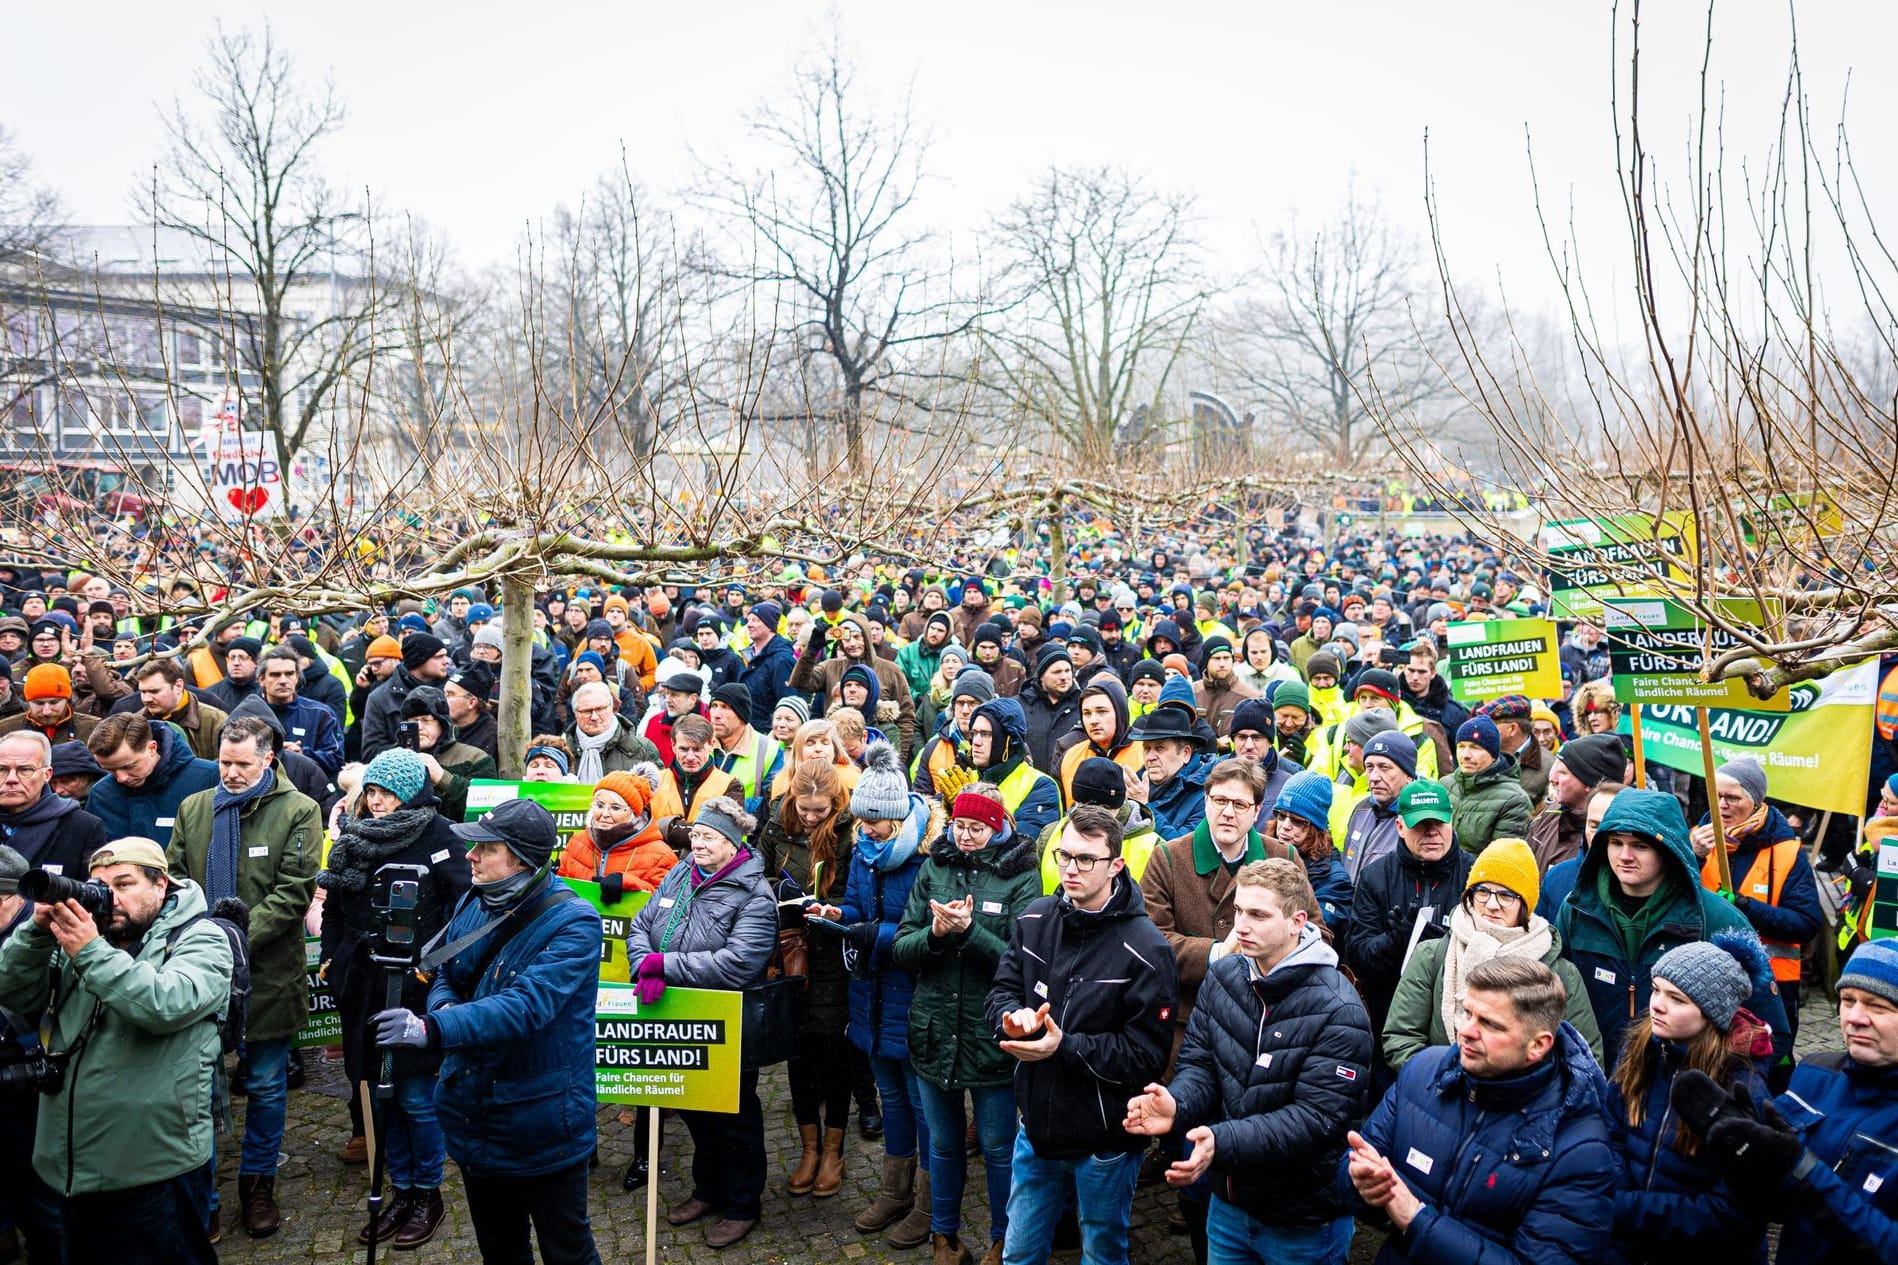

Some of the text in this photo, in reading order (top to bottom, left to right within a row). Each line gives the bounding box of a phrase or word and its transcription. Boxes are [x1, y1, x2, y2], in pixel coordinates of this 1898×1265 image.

[210, 461, 280, 486] MOB
[1458, 639, 1543, 660] LANDFRAUEN
[1461, 657, 1533, 677] FÜRS LAND!
[1629, 653, 1678, 672] FÜRS
[1633, 677, 1658, 687] Faire
[1634, 686, 1728, 697] ländliche Räume!
[1640, 727, 1703, 752] aire Chanc
[1769, 753, 1819, 768] Räume!
[1411, 797, 1440, 806] Bauern
[308, 1018, 322, 1028] ire
[595, 1022, 718, 1040] LANDFRAUEN
[595, 1045, 702, 1066] FÜRS LAND!
[595, 1072, 685, 1082] Faire Chancen für
[596, 1084, 685, 1096] ländliche Räume!
